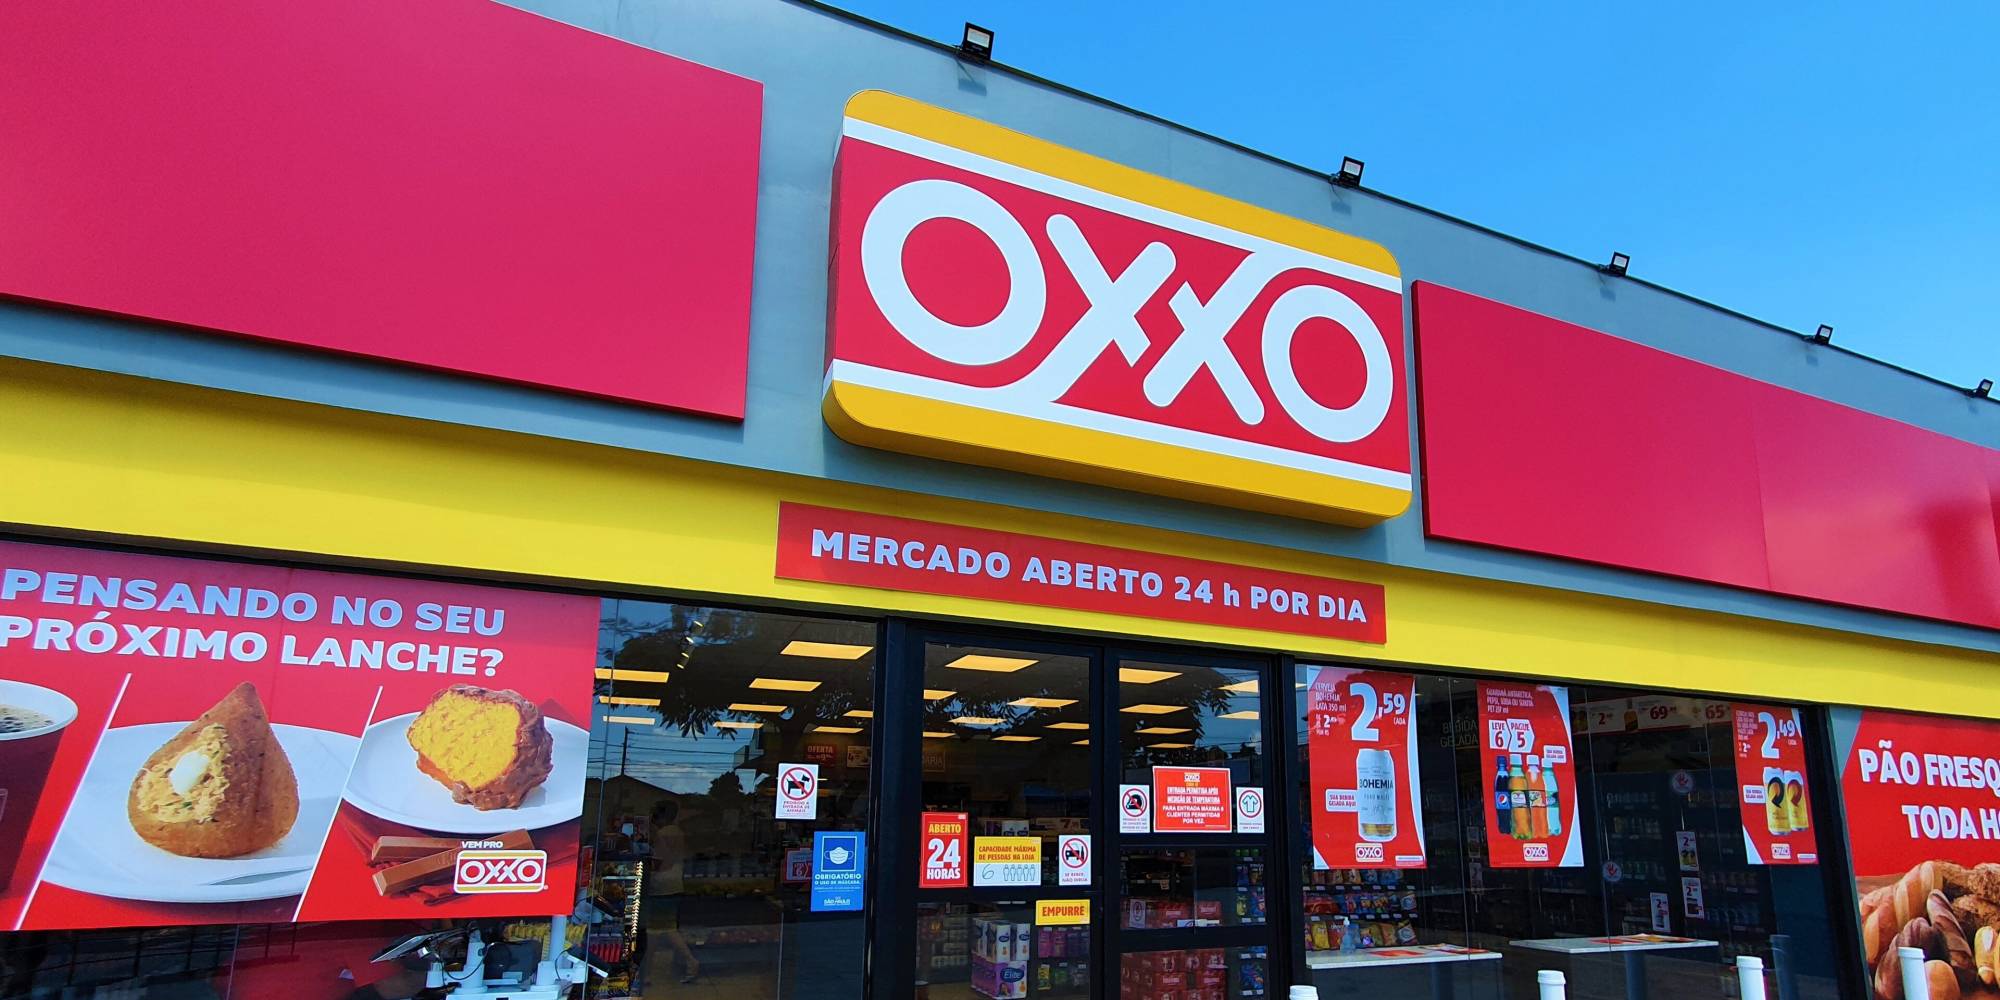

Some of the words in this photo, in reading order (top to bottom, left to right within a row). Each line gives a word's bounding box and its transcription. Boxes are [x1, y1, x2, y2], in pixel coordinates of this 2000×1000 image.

[861, 178, 1394, 443] OXXO
[811, 528, 1011, 579] MERCADO
[1022, 557, 1163, 597] ABERTO
[1174, 576, 1213, 604] 24
[1223, 582, 1240, 607] h
[1250, 586, 1309, 616] POR
[1318, 595, 1367, 622] DIA
[1, 568, 318, 622] PENSANDO
[331, 595, 403, 628] NO
[415, 602, 505, 636] SEU
[0, 611, 268, 662] PRÓXIMO
[280, 634, 504, 677] LANCHE?
[1315, 692, 1340, 702] BOHEMIA
[1492, 722, 1505, 731] LEVE
[1511, 722, 1530, 731] PAGUE
[1495, 730, 1504, 748] 6
[1517, 731, 1526, 748] 5
[1858, 739, 1920, 785] PÃO
[1923, 753, 2000, 798] FRESQ
[1359, 778, 1394, 789] BOHEMIA
[928, 823, 961, 834] ABERTO
[1901, 805, 1979, 839] TODA
[1979, 807, 2000, 840] H
[927, 838, 961, 868] 24
[979, 845, 1012, 853] CAPACIDADE
[1013, 844, 1036, 853] MÁXIMA
[1357, 847, 1382, 858] OXXO
[1524, 847, 1547, 857] OXXO
[460, 859, 541, 885] OXXO
[926, 868, 961, 879] HORAS
[982, 864, 994, 879] 6
[1042, 906, 1085, 916] EMPURRE
